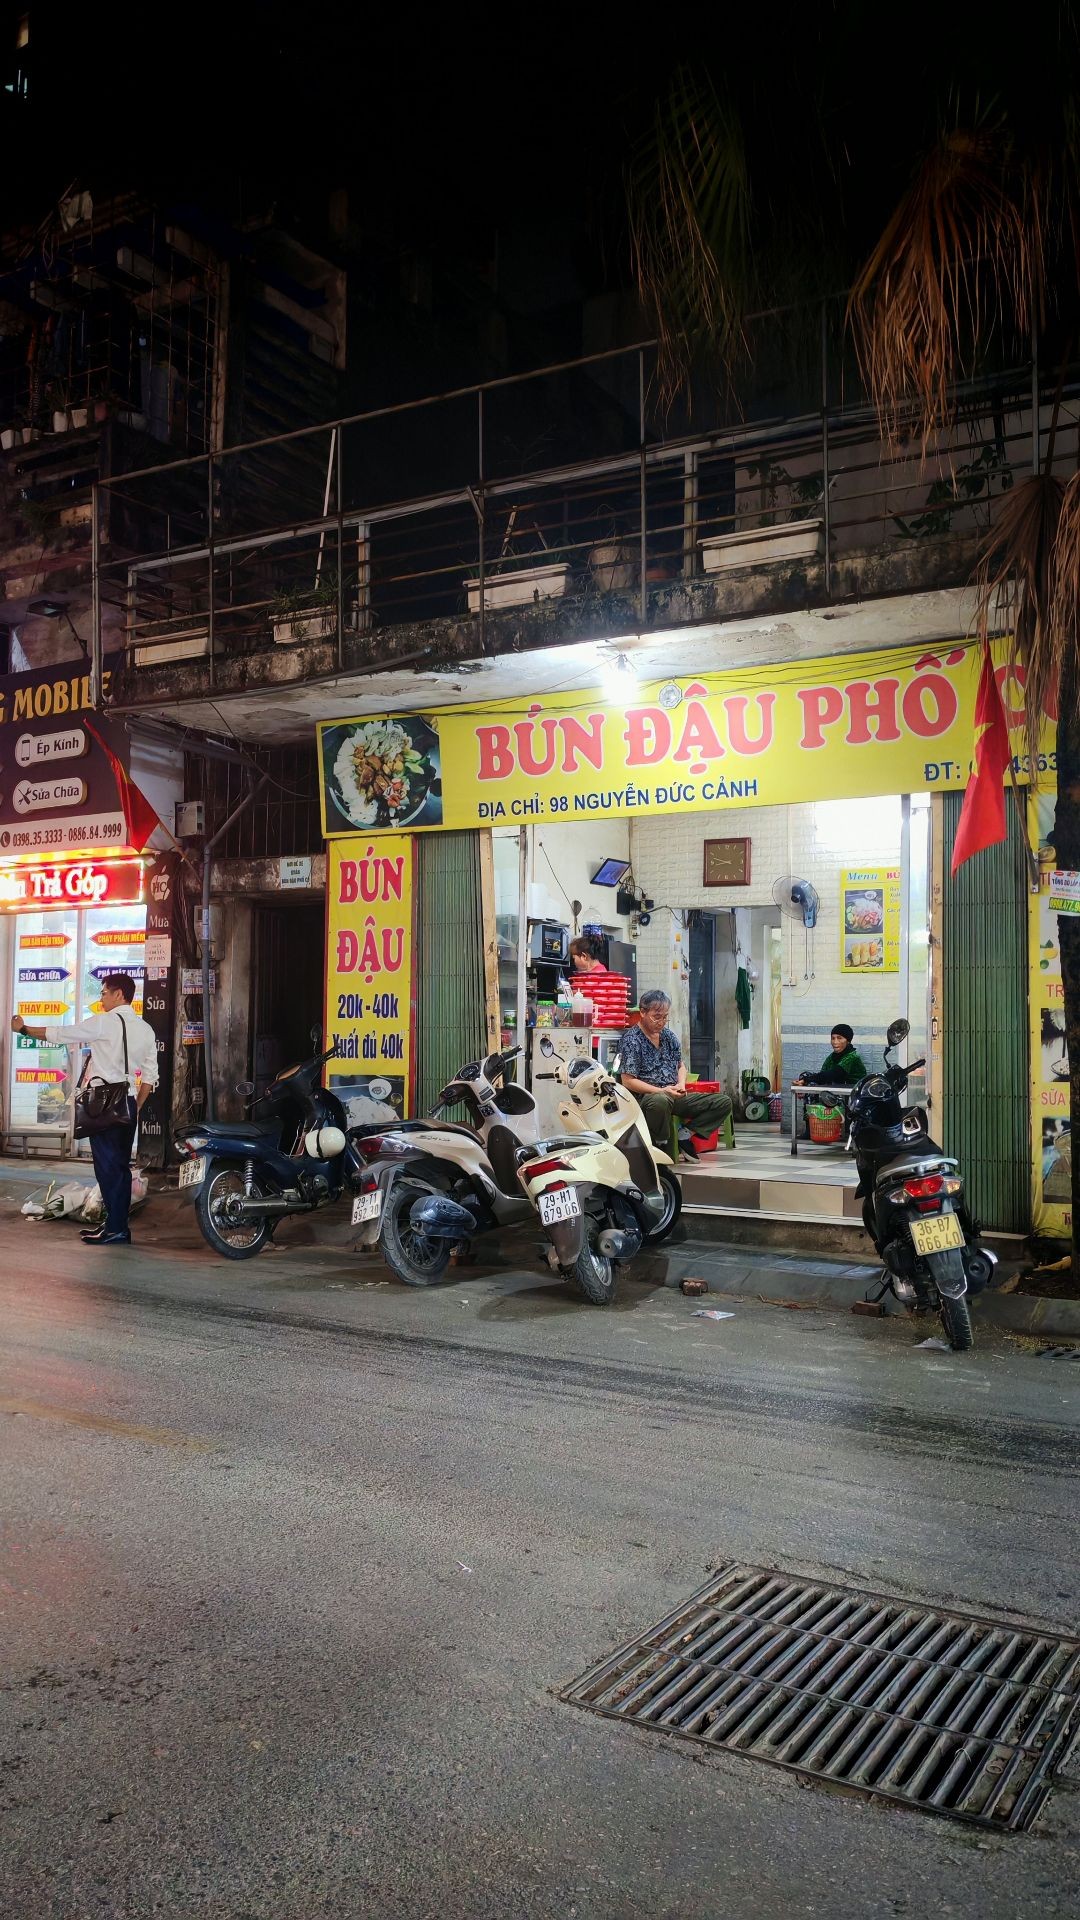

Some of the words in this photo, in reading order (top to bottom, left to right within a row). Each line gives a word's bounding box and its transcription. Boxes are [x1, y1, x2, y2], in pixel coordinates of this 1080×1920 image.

[475, 704, 605, 780] BÚN
[623, 682, 776, 775] ĐẬU
[797, 649, 967, 749] PHỐ
[36, 739, 50, 756] Ép
[53, 736, 79, 752] Kính
[924, 761, 960, 781] ĐT:
[31, 787, 51, 801] Sửa
[53, 784, 80, 799] Chữa
[478, 801, 506, 821] ĐỊA
[511, 792, 544, 815] CHỈ:
[549, 796, 568, 812] 98
[574, 782, 650, 811] NGUYỄN
[655, 781, 696, 804] ĐỨC
[702, 776, 758, 800] CẢNH
[12, 828, 63, 847] 0398.35.3333
[68, 822, 122, 843] 0886.84.9999
[65, 865, 108, 902] Góp
[339, 846, 404, 903] BÚN
[847, 871, 878, 880] Menu
[886, 869, 900, 879] BÚ
[336, 915, 404, 984] ĐẬU
[20, 970, 36, 981] SỬA
[38, 969, 61, 981] CHỮA
[20, 1004, 41, 1014] THAY
[46, 1003, 60, 1013] PIN
[146, 996, 165, 1010] Sửa
[337, 993, 363, 1018] 20k
[373, 993, 398, 1018] 40k
[20, 1037, 34, 1048] ÉP
[332, 1027, 359, 1058] Xuất
[362, 1030, 377, 1059] đủ
[381, 1033, 404, 1058] 40k
[17, 1071, 36, 1082] THAY
[38, 1070, 57, 1082] MÀN
[1041, 1088, 1066, 1106] SỮA
[141, 1119, 161, 1135] Kính
[357, 1193, 377, 1209] 29-T1
[545, 1190, 572, 1208] 29-H1
[543, 1202, 578, 1222] 879.06
[917, 1216, 950, 1236] 36-B7
[918, 1231, 960, 1253] 866.40
